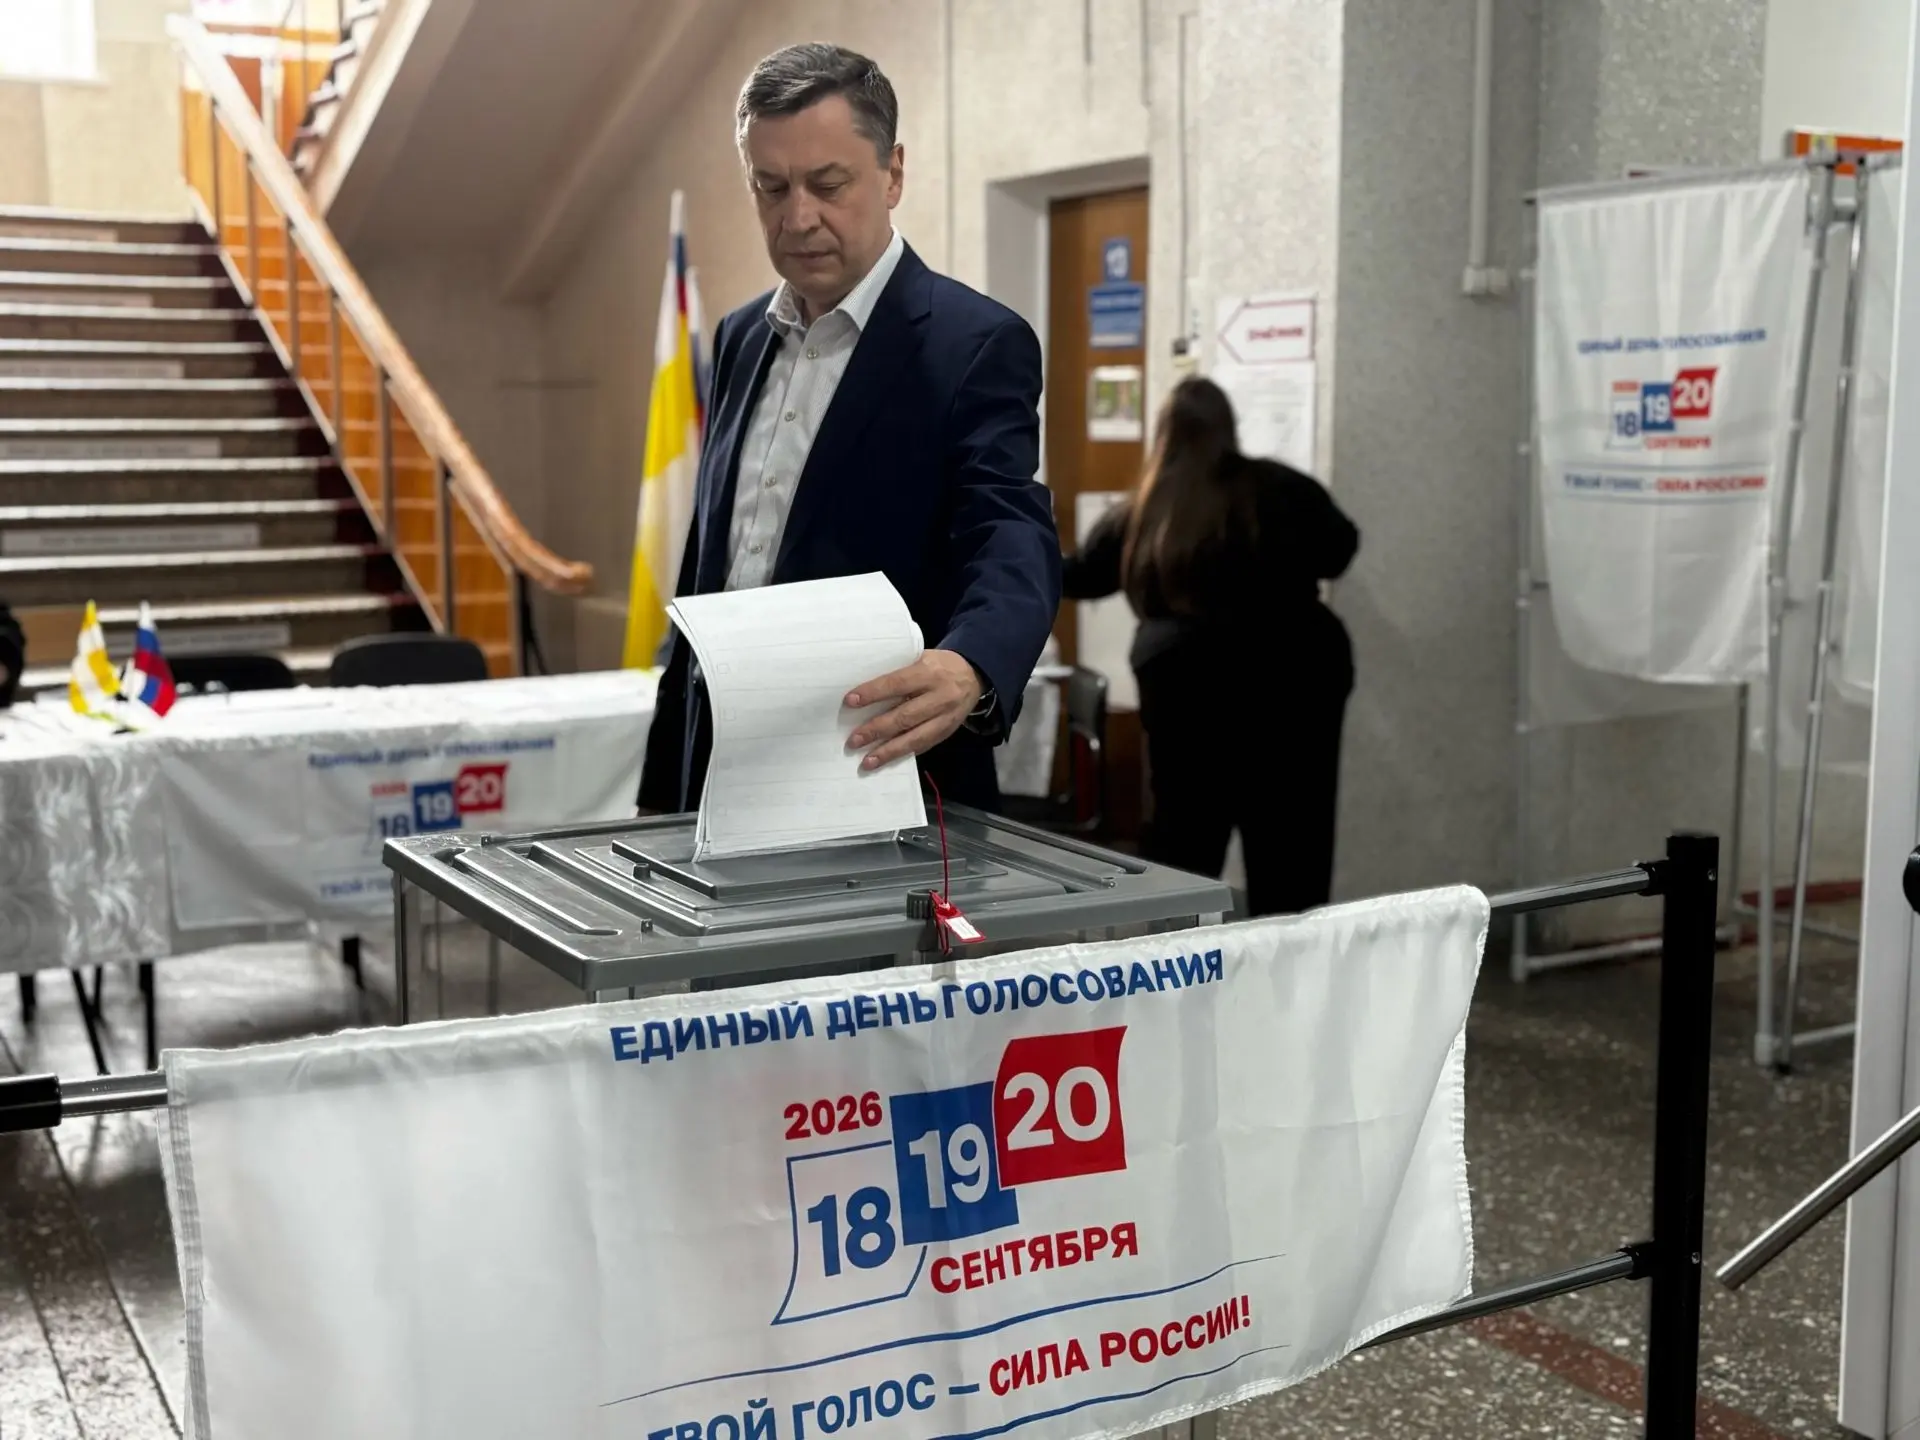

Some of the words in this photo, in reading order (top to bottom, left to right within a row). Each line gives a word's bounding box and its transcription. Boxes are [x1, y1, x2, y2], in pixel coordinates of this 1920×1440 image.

[1645, 393, 1671, 424] 19
[1673, 377, 1711, 409] 20
[1615, 411, 1638, 437] 18
[418, 792, 454, 823] 19
[460, 773, 501, 806] 20
[379, 814, 410, 837] 18
[610, 1001, 814, 1064] ЕДИНЫЙ
[826, 990, 937, 1040] ДЕНЬ
[941, 949, 1223, 1019] ГОЛОСОВАНИЯ
[784, 1091, 883, 1140] 2026
[1003, 1066, 1111, 1151] 20
[909, 1123, 990, 1209] 19
[807, 1186, 896, 1277] 18
[931, 1222, 1138, 1294] СЕНТЯБРЯ
[792, 1373, 936, 1436] ГОЛОС
[989, 1338, 1090, 1396] СИЛА
[1099, 1295, 1251, 1368] РОССИИ!
